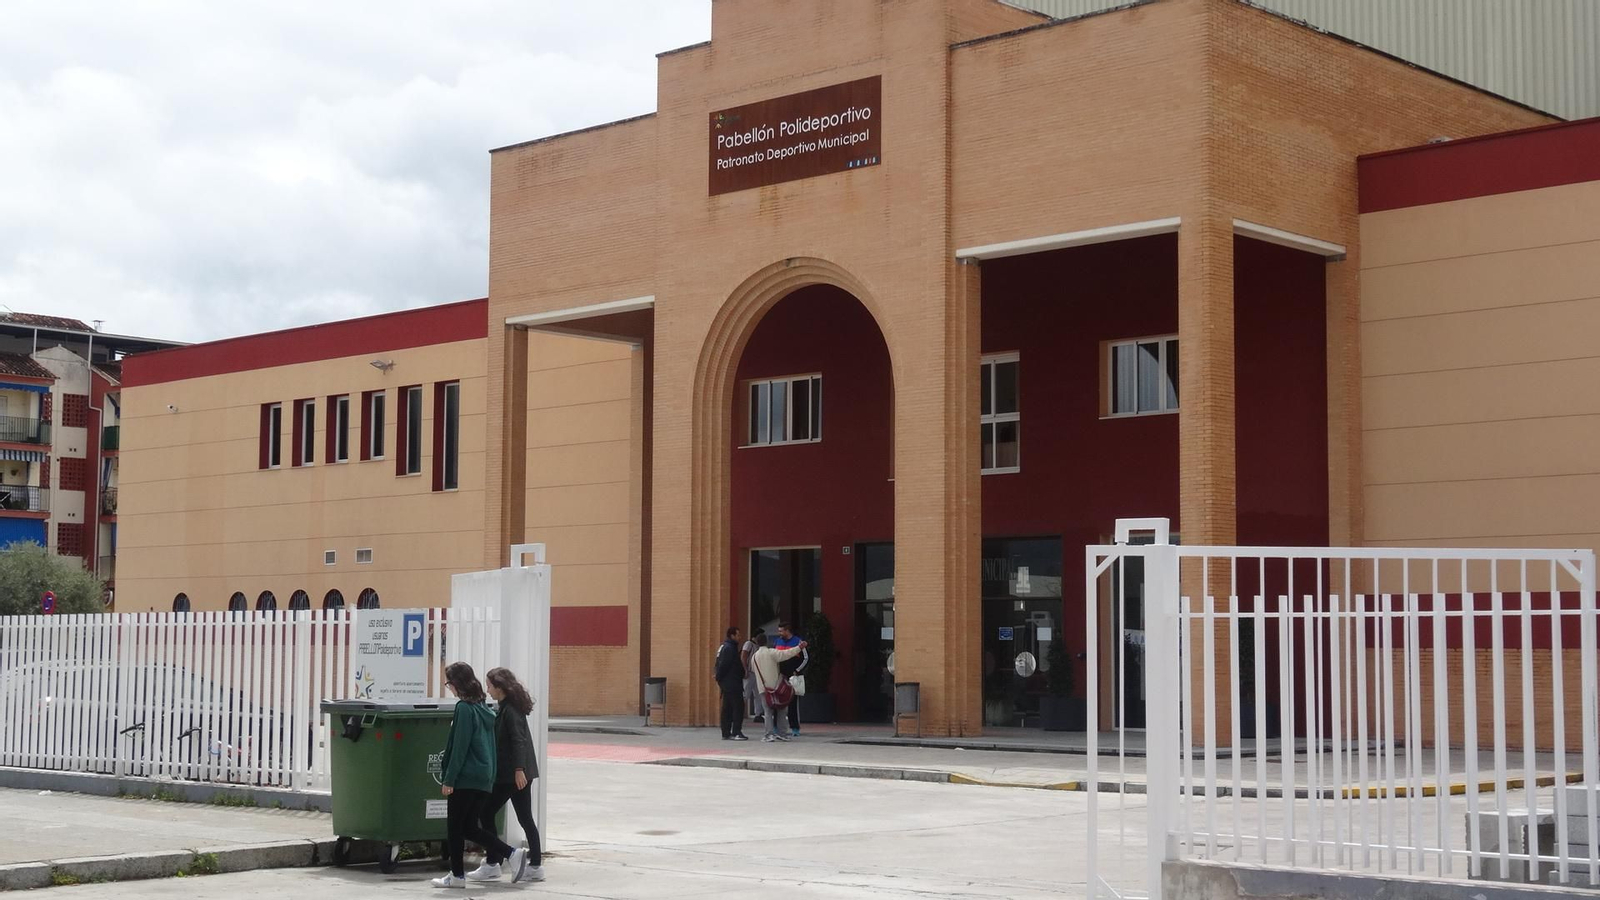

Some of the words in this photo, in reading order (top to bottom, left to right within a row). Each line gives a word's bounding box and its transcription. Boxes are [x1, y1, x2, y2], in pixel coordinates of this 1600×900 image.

[717, 124, 774, 150] Pabellón
[780, 107, 871, 137] Polideportivo
[717, 152, 764, 170] Patronato
[766, 142, 816, 162] Deportivo
[817, 128, 869, 150] Municipal
[407, 620, 422, 650] P
[428, 754, 444, 762] REC
